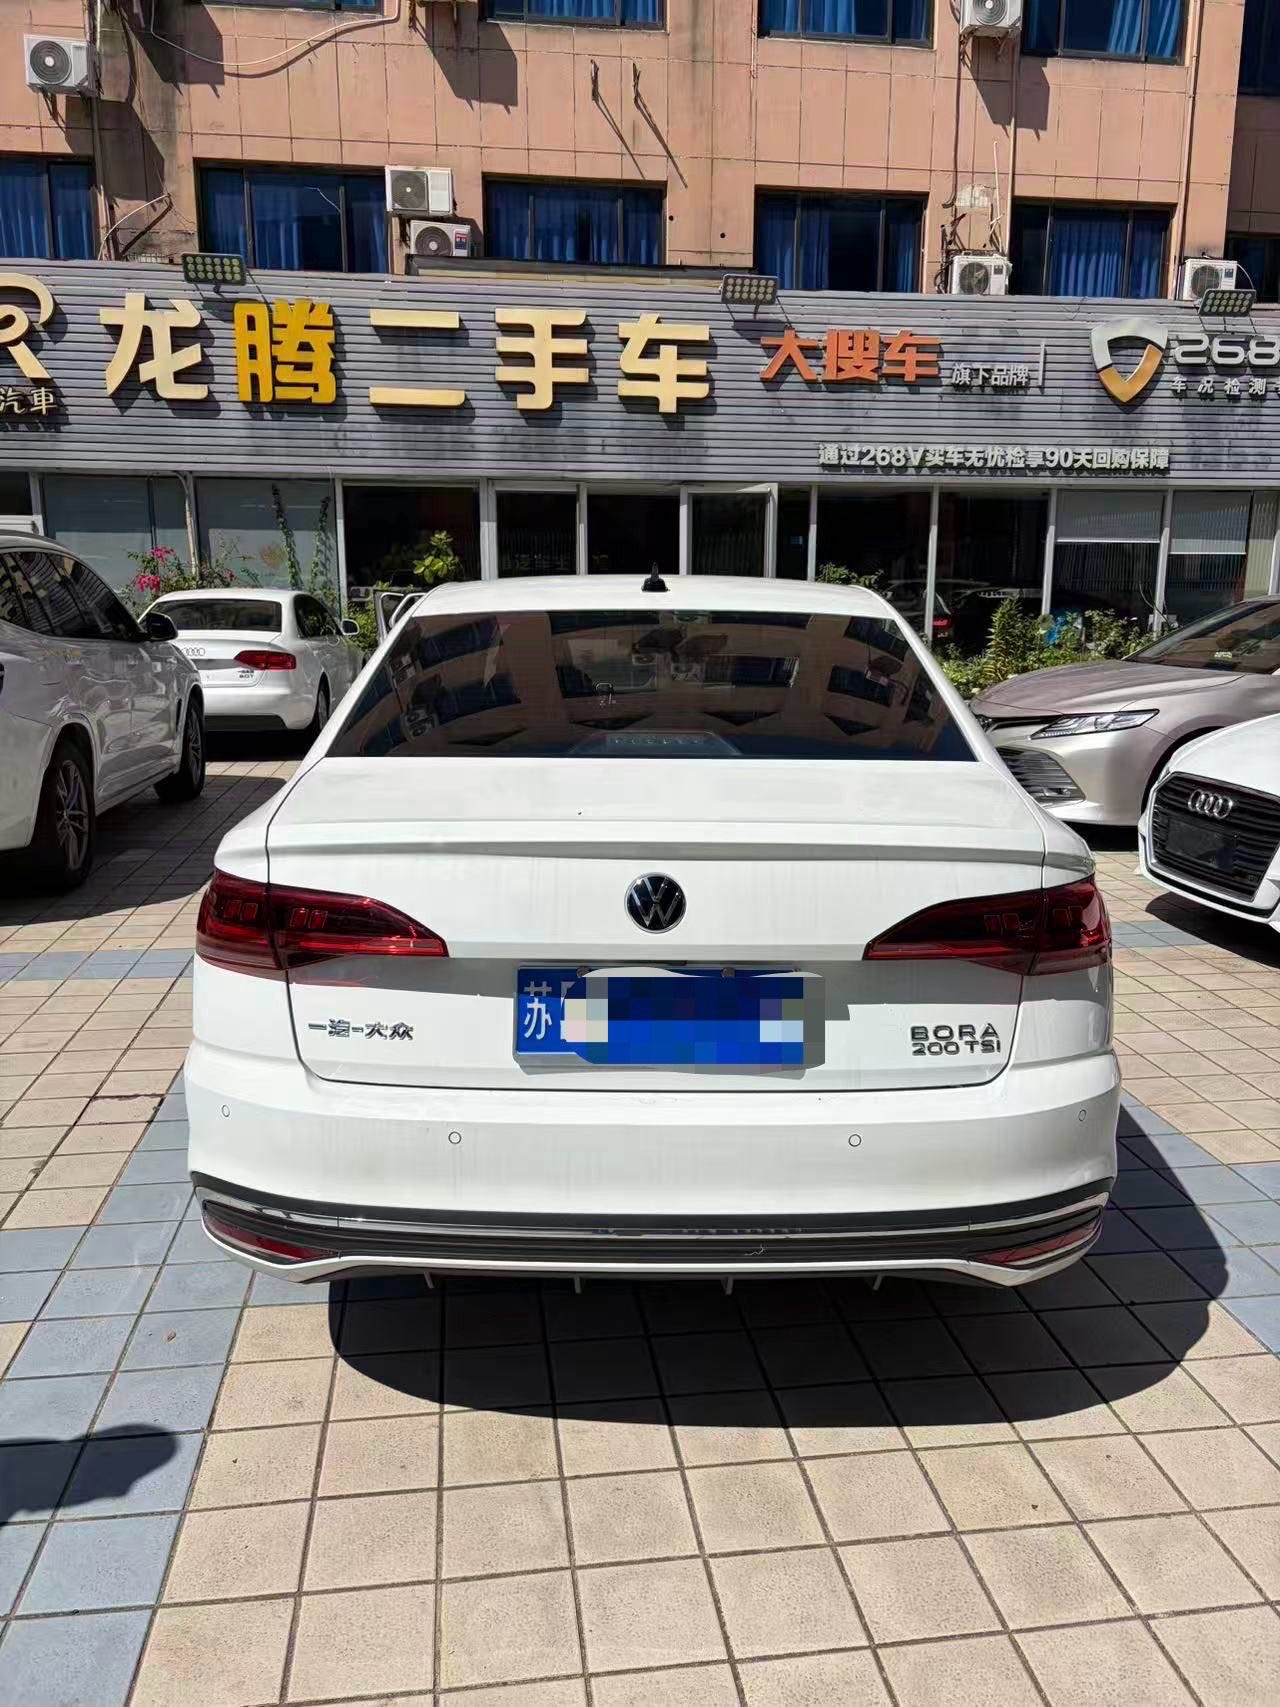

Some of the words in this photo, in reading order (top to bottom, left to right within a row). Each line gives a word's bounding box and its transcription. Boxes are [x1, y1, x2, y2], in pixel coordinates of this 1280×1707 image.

[98, 292, 711, 413] 龙腾二手车
[759, 325, 941, 383] 大搜车
[951, 362, 1028, 386] 旗下品牌
[1174, 333, 1280, 365] 268
[1170, 376, 1280, 396] 车况检测
[308, 1018, 414, 1041] 一汽-大众
[910, 1022, 999, 1041] BORA
